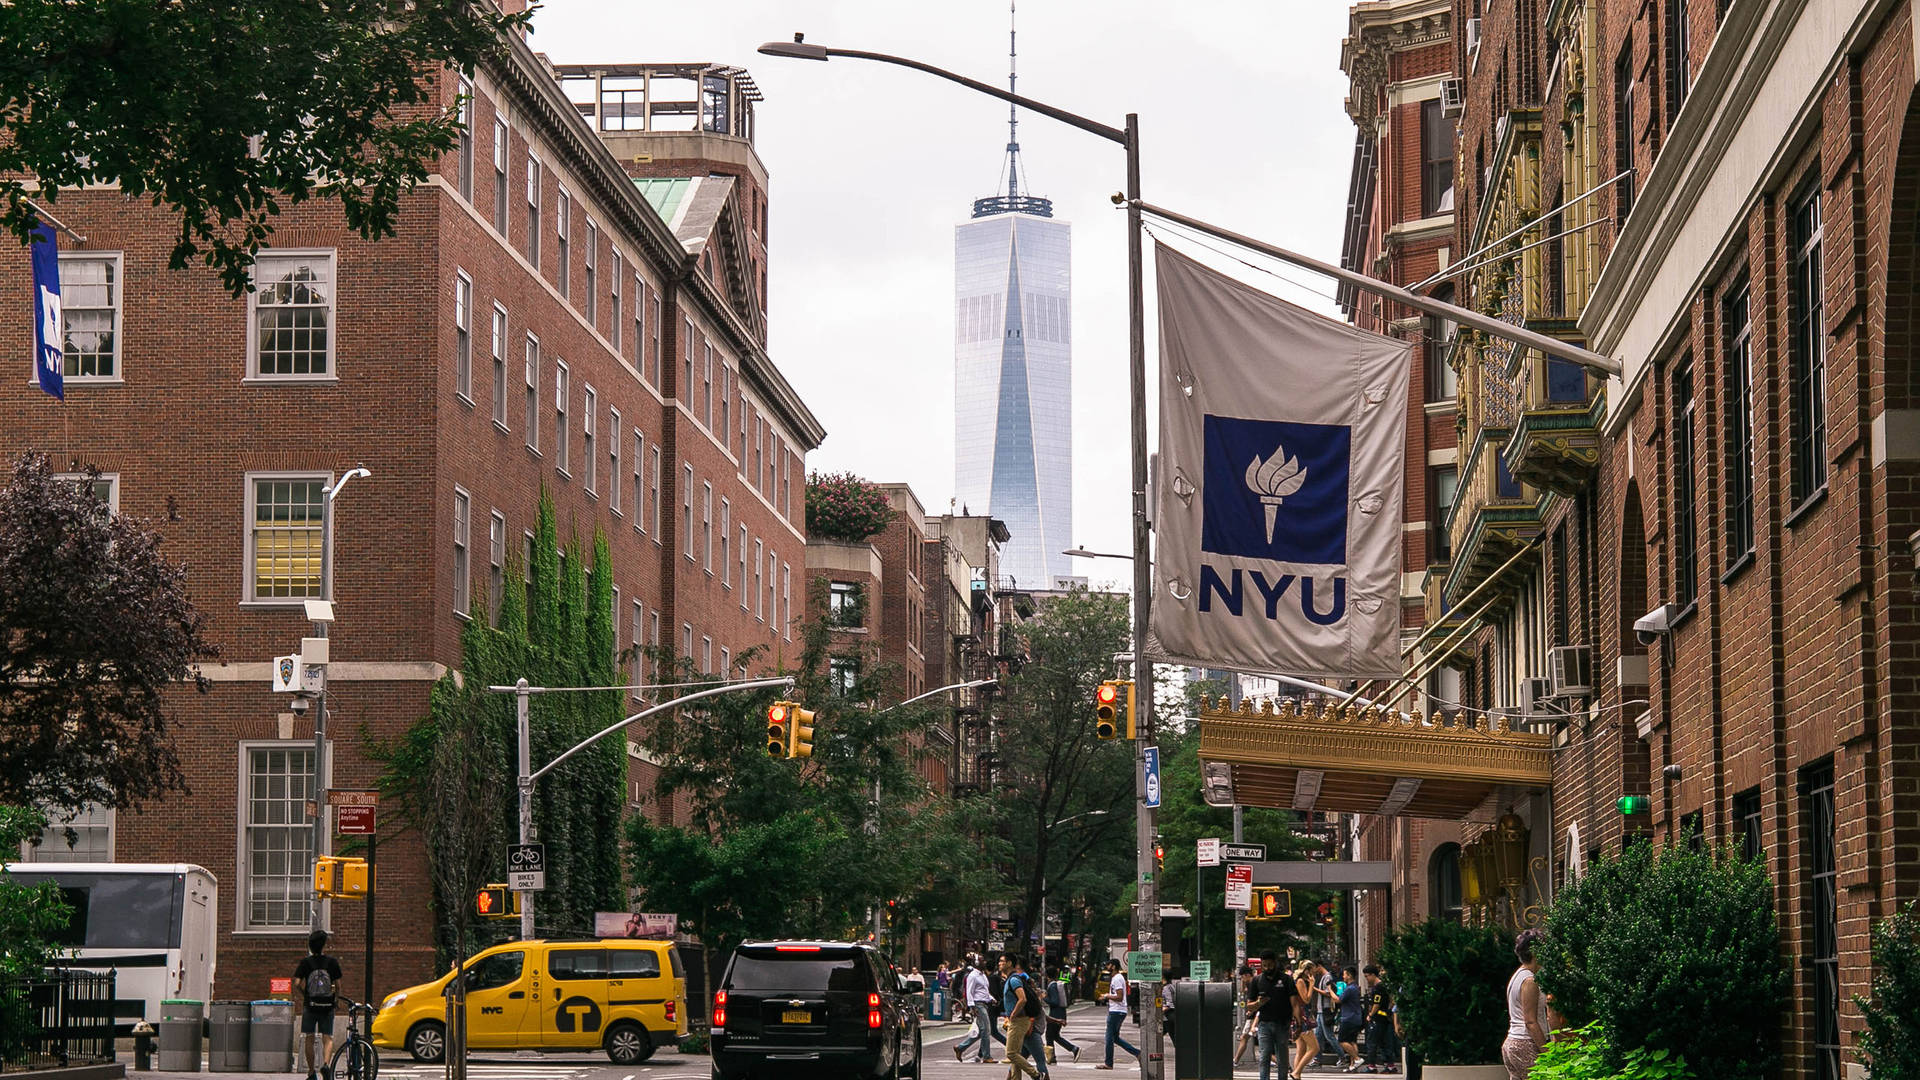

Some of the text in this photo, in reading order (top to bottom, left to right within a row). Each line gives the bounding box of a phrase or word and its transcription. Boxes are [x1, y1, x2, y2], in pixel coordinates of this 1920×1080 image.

[1198, 563, 1346, 626] NYU
[330, 795, 376, 804] SQUARE SOUTH
[1225, 848, 1260, 857] ONE WAY
[481, 1006, 504, 1015] NYC
[565, 1005, 591, 1033] T
